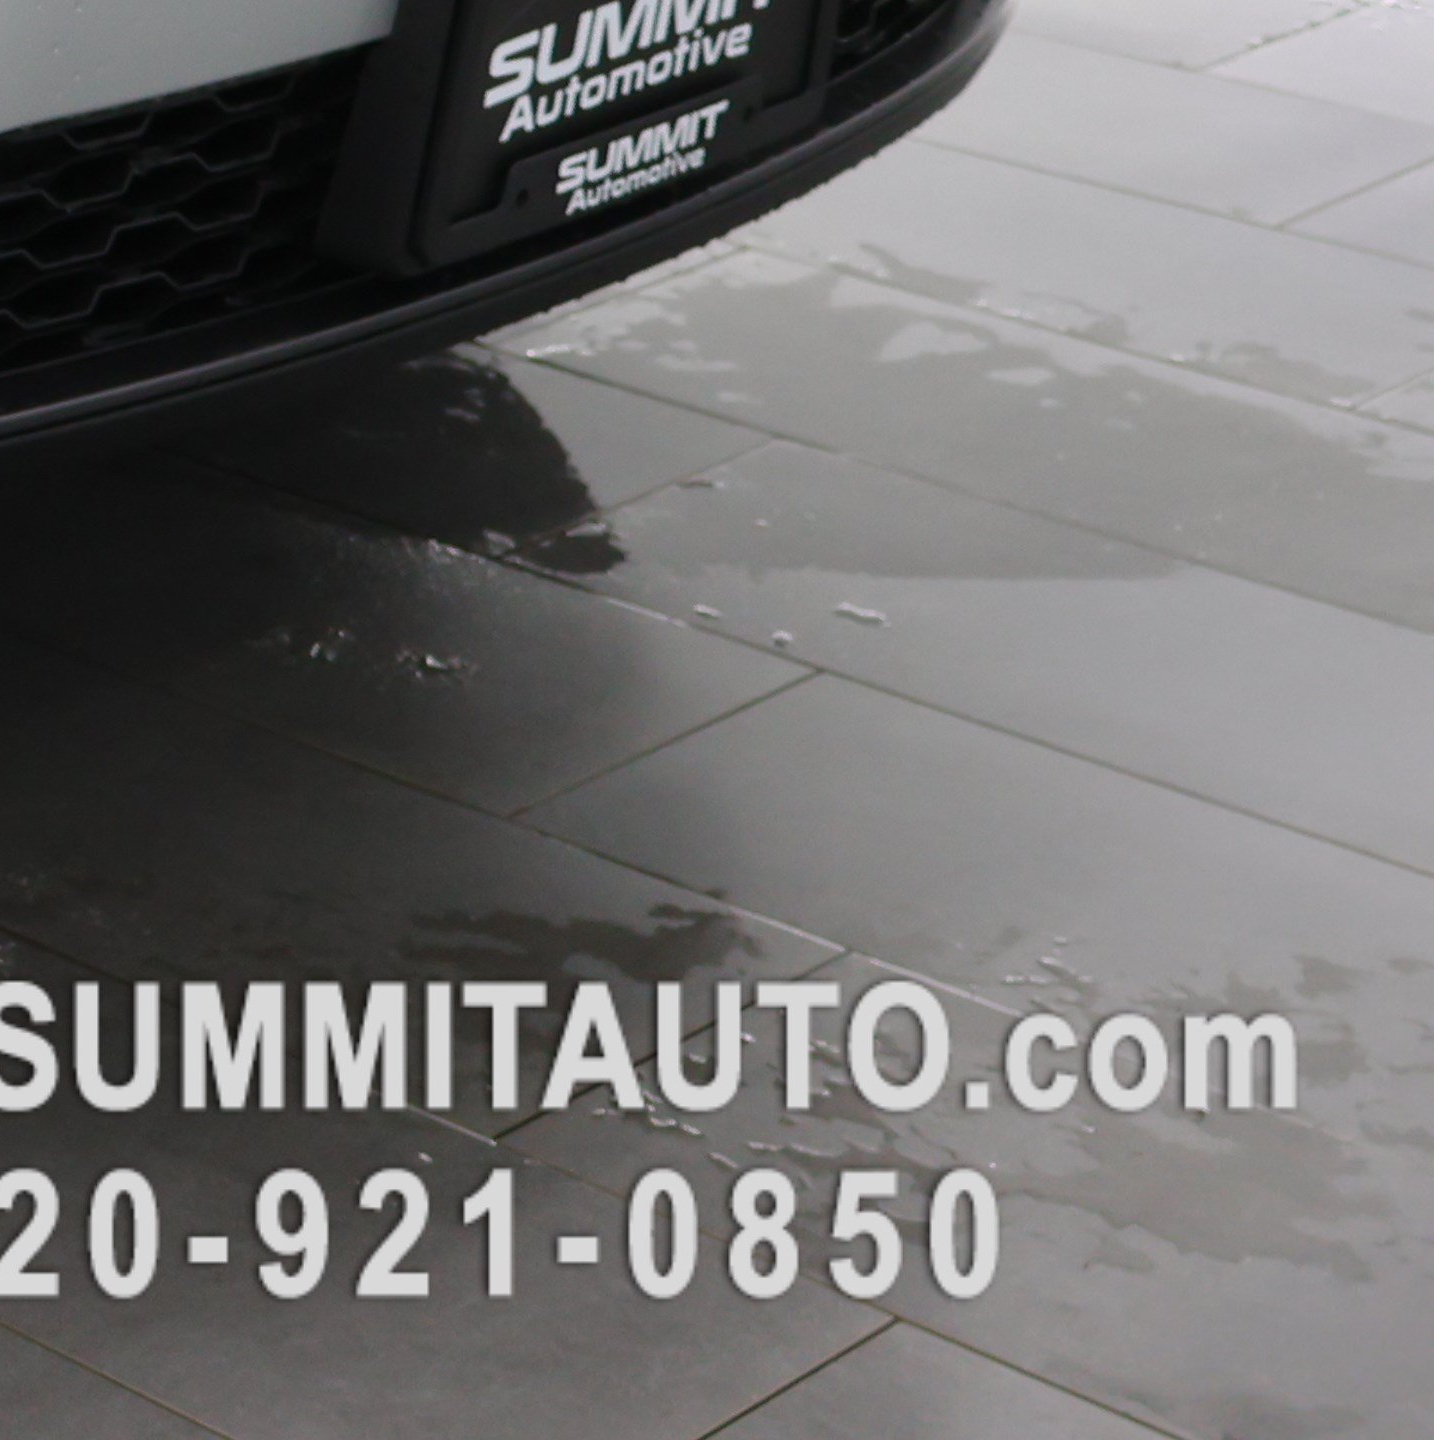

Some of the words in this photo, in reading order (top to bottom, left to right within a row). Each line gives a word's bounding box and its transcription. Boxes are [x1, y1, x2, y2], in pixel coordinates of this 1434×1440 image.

[500, 23, 753, 144] Automotive
[556, 101, 730, 194] SUMMIT
[566, 147, 706, 216] Automotive
